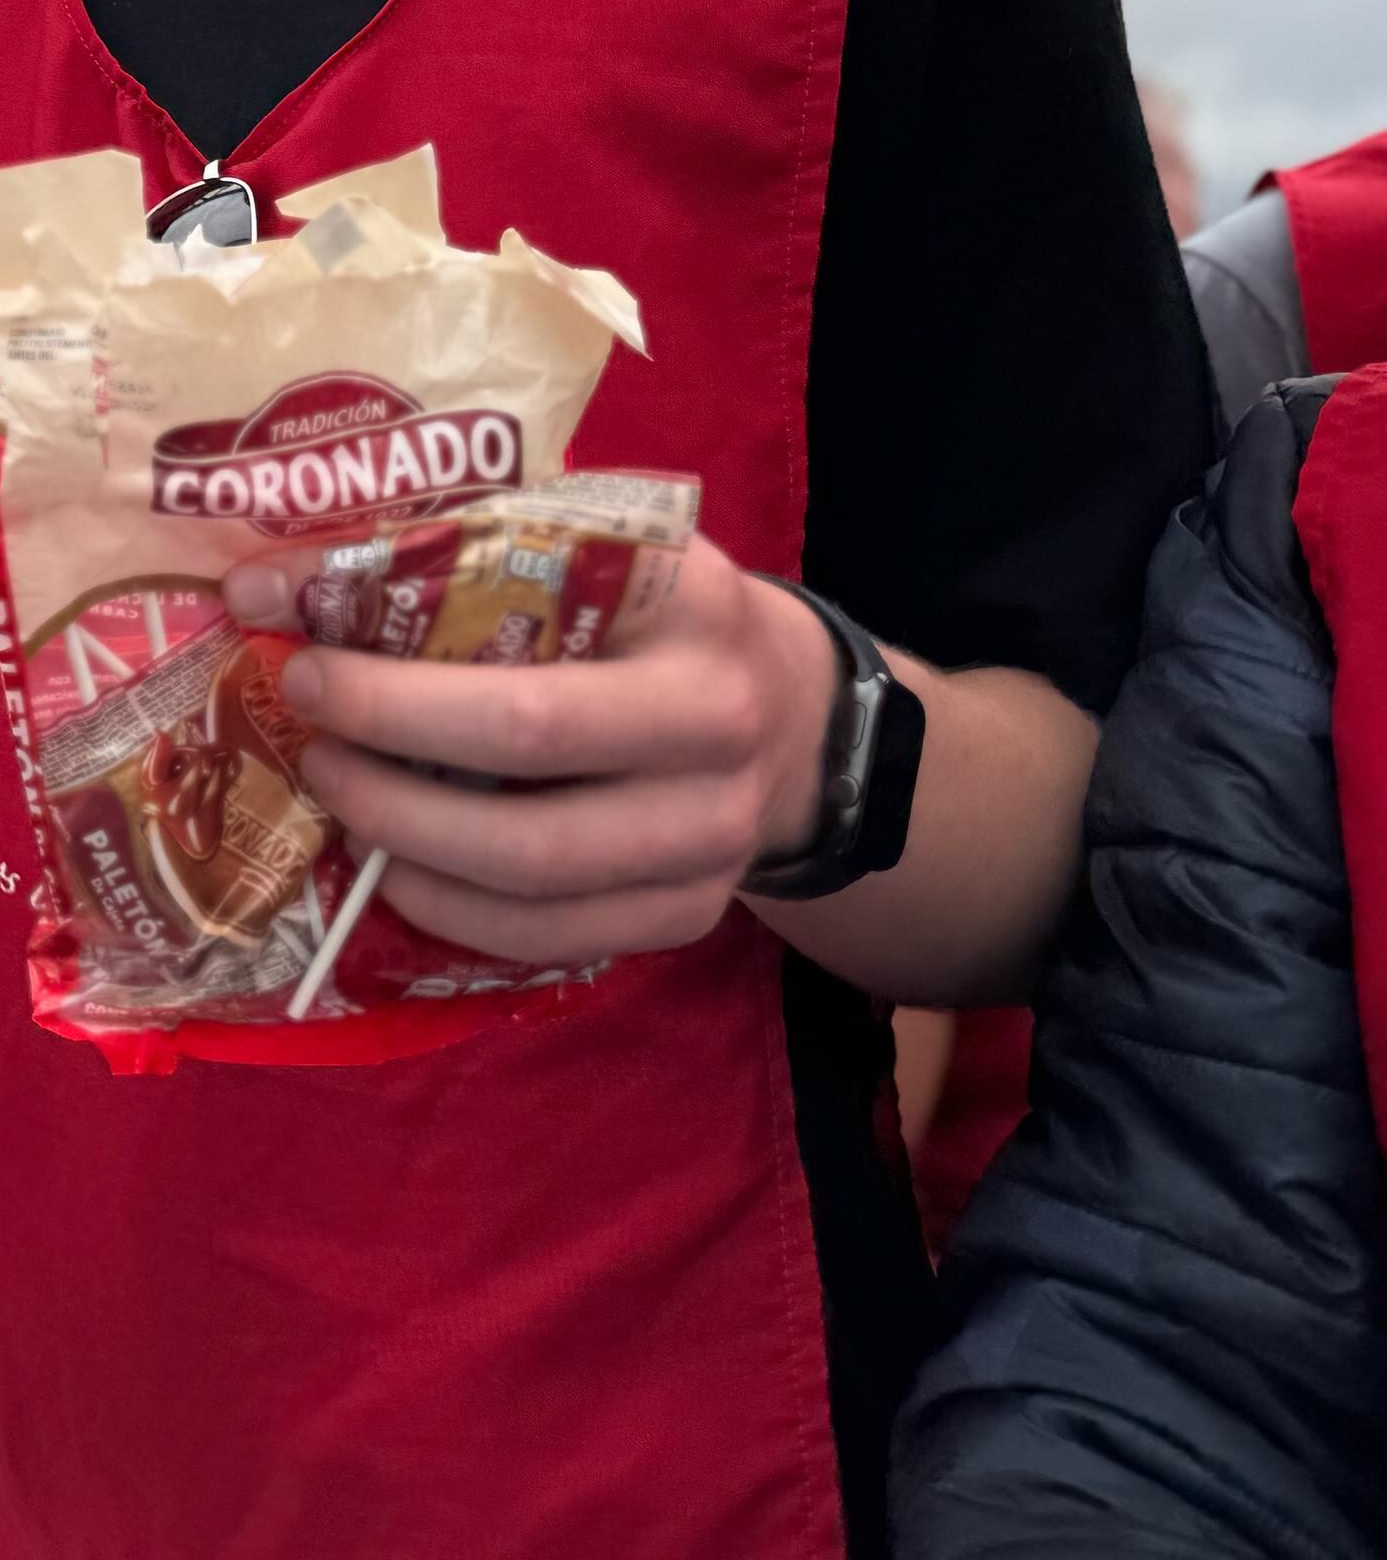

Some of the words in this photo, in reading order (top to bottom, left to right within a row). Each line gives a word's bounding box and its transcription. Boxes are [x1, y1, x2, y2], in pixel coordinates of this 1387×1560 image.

[161, 416, 515, 517] CORONADO
[270, 398, 387, 443] TRADICIÓN
[83, 829, 168, 957] PALETÓN
